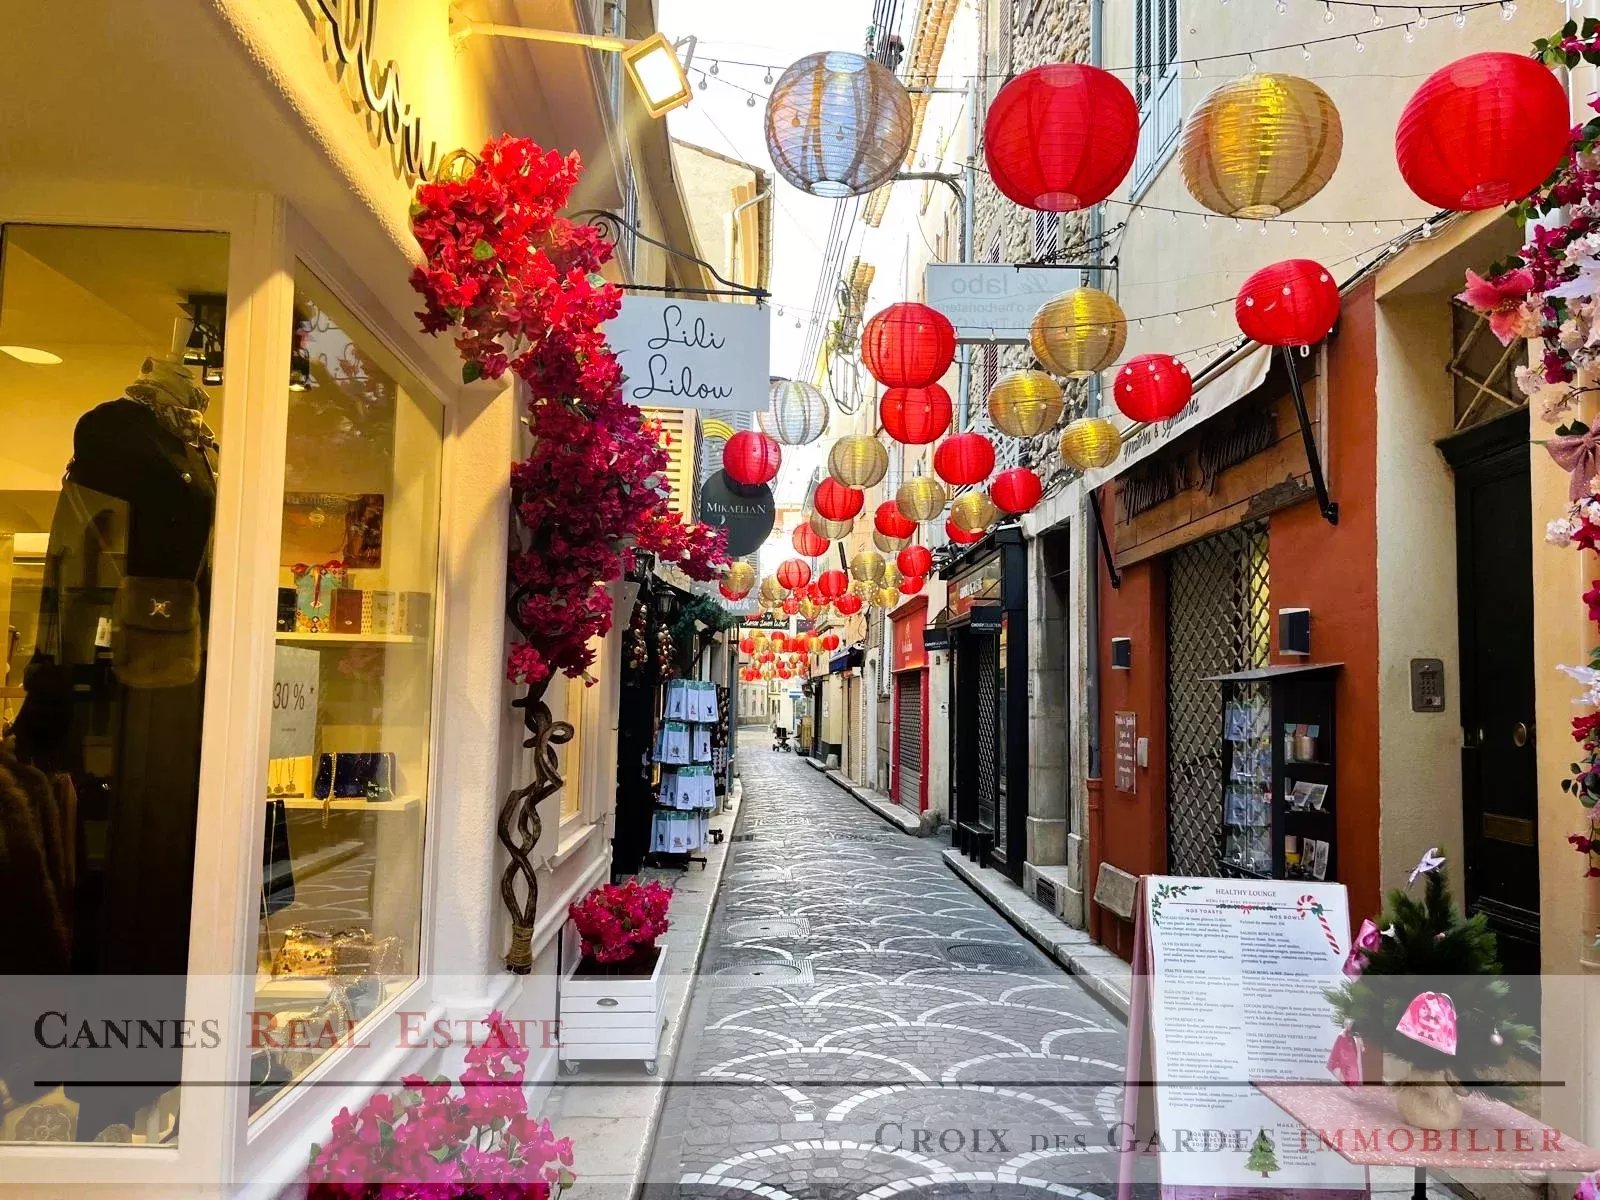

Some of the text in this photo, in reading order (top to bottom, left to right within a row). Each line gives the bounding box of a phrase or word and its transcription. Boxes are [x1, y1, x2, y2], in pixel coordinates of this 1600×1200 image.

[648, 305, 725, 349] Lili
[633, 353, 732, 399] Lilou
[706, 502, 766, 515] MIKAELIAN
[293, 682, 305, 711] %
[1216, 889, 1277, 898] HEALTHY LOUNGE
